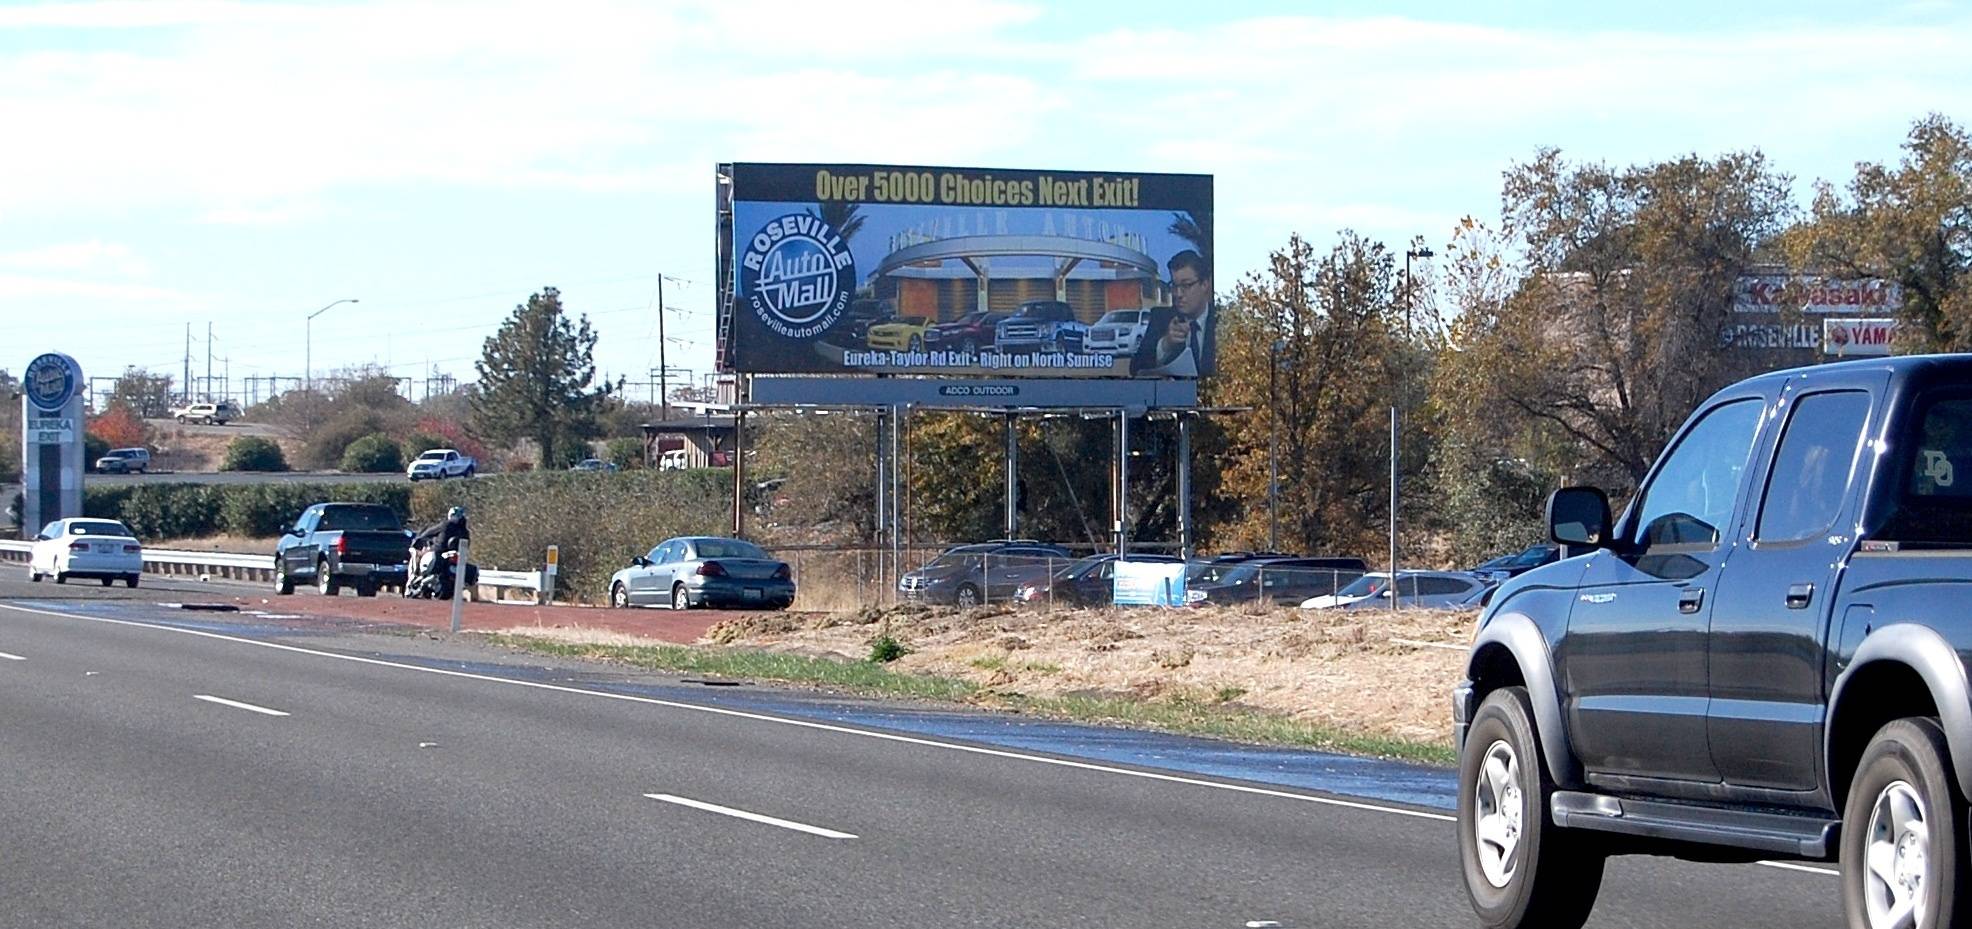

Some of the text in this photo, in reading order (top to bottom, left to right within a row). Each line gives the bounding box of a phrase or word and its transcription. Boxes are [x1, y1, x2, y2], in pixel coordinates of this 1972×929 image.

[816, 170, 1139, 206] Over 5000 Choices Next Exit!
[743, 215, 853, 271] ROSEVILLE
[769, 250, 828, 281] Auto
[778, 275, 830, 310] Mall
[750, 291, 849, 338] rosevilleautomall.com
[843, 350, 1113, 369] Eureka-Taylor Rd Exit Right on North Sunrise
[945, 386, 1014, 395] ADCO OUTDOOR
[28, 420, 73, 430] EUREKA
[38, 432, 60, 441] EXIT
